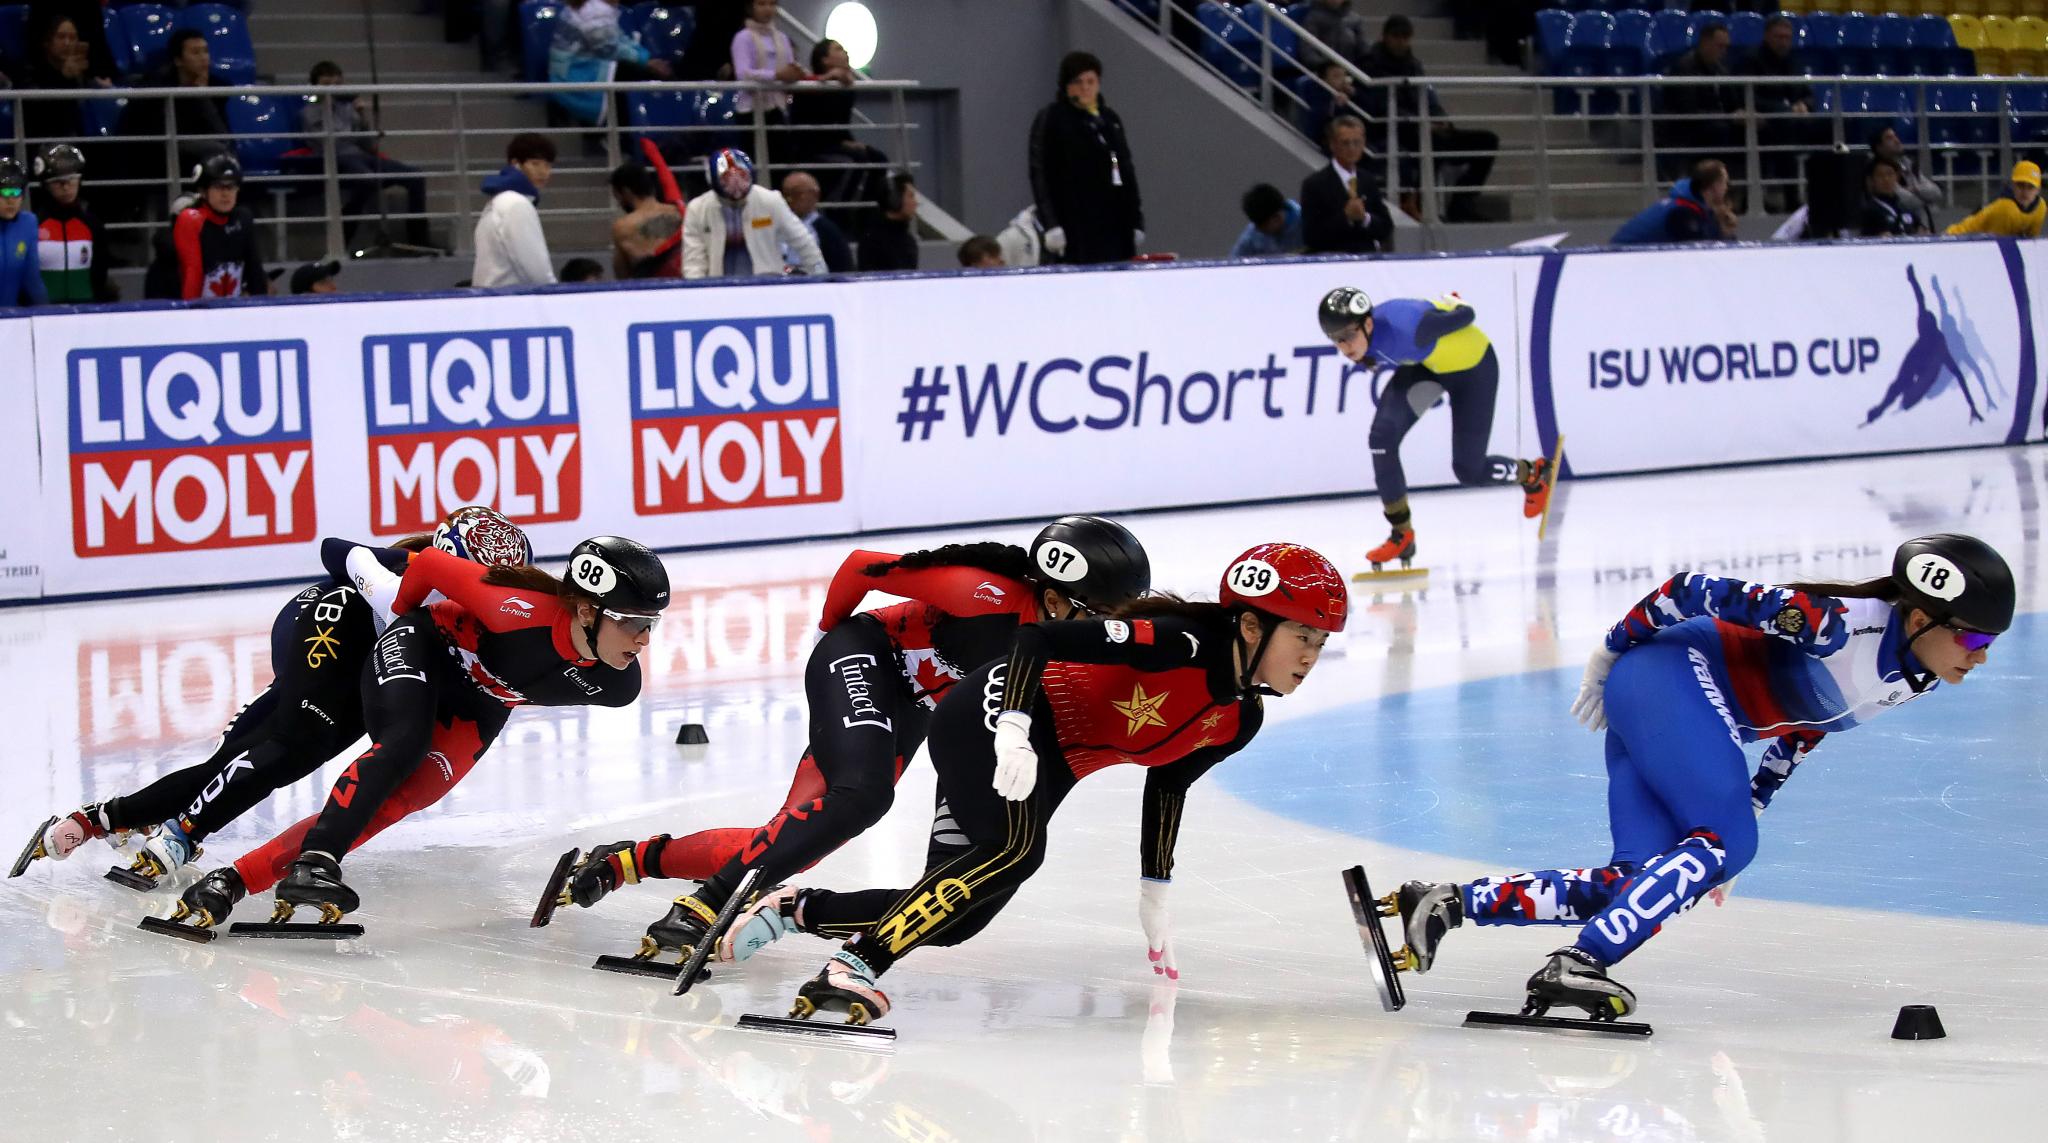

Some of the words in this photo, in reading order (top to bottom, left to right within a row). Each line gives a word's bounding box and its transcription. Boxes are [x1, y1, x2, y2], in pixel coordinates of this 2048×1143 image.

[373, 336, 569, 426] LIQUI
[639, 324, 829, 410] LIQUI
[1589, 350, 1649, 389] ISU
[1660, 342, 1799, 384] WORLD
[1807, 337, 1880, 376] CUP
[79, 350, 301, 443] LIQUI
[378, 433, 577, 526] MOLY
[642, 417, 836, 506] MOLY
[84, 450, 309, 548] MOLY
[578, 559, 604, 587] 98
[1045, 547, 1076, 574] 97
[1233, 564, 1271, 591] 139
[1920, 561, 1951, 591] 18
[499, 605, 532, 619] LI-NING
[973, 592, 1002, 606] LI-NING
[307, 703, 335, 725] SCOTT
[877, 878, 972, 954] CHN
[1594, 852, 1706, 945] RUS
